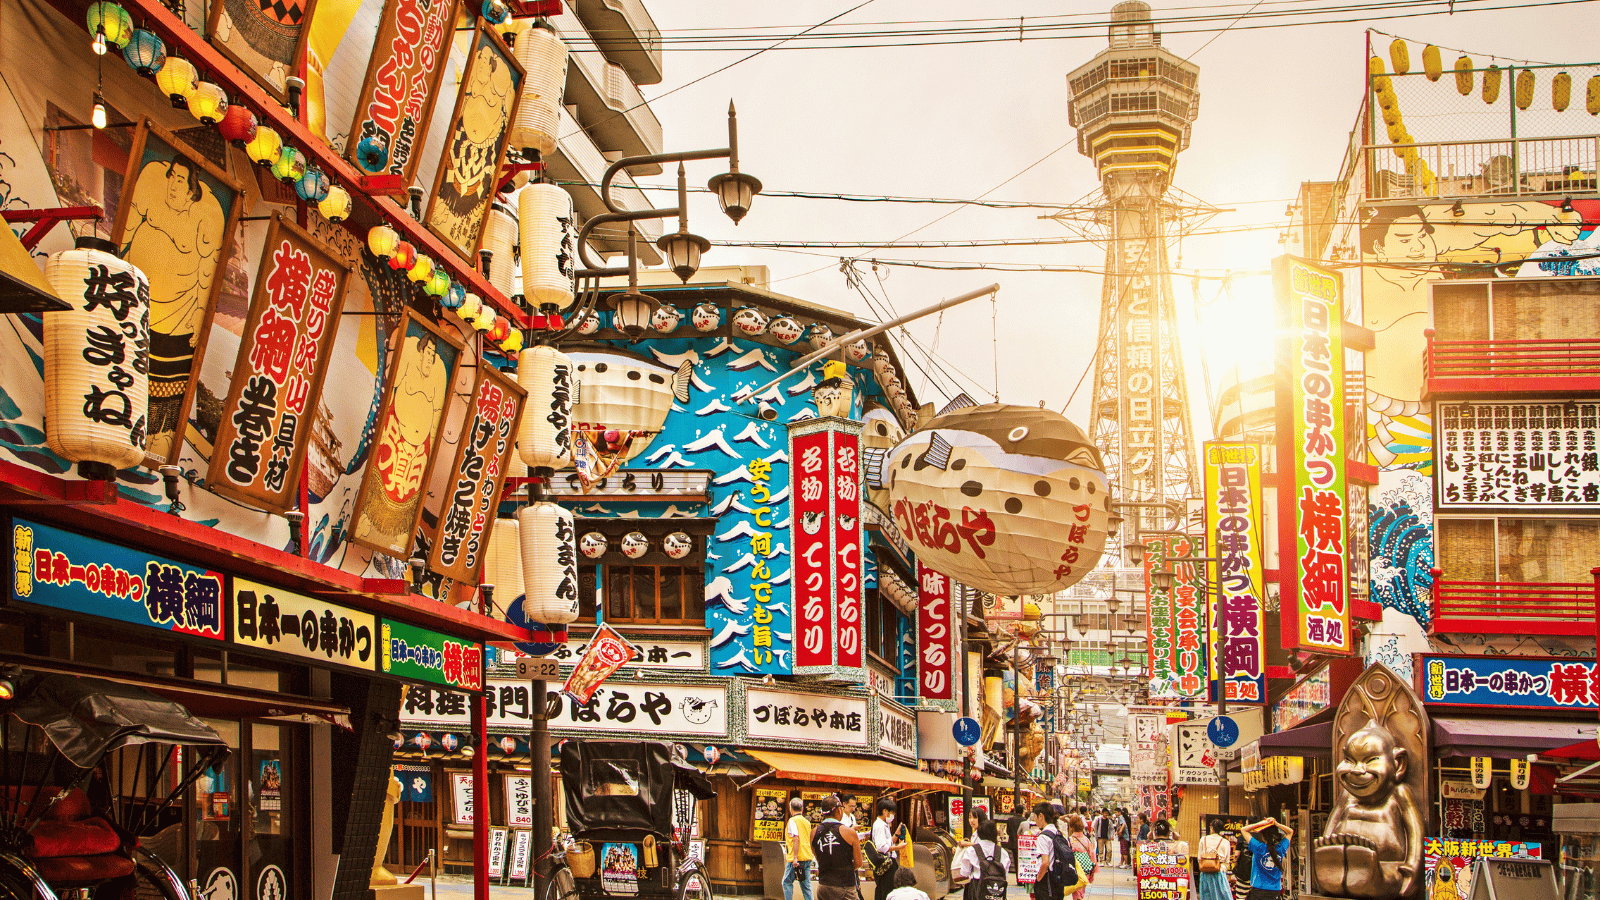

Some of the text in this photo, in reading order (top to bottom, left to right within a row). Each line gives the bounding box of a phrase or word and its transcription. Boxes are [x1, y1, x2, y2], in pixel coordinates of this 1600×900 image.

[229, 242, 312, 484] 横綱巻き
[266, 270, 335, 491] 盛り沢山具材
[442, 380, 502, 565] 揚げたこ焼き
[1210, 448, 1255, 464] 新世界
[1294, 267, 1343, 643] 新世界 日本一の串かつ 横綱 酒処
[1445, 453, 1460, 502] もち
[1462, 453, 1479, 502] うずら玉子
[1478, 453, 1495, 502] 紅しょうが
[1495, 453, 1512, 502] にんにく
[1512, 453, 1530, 502] 玉ねぎ
[1530, 453, 1546, 502] 山芋
[1547, 453, 1563, 502] しし唐
[1564, 453, 1581, 502] れんこん
[1581, 453, 1599, 502] 銀杏
[802, 446, 824, 655] 名物 てっちり
[837, 446, 857, 655] 名物 てっちり
[894, 496, 996, 559] づぼらや
[1053, 503, 1093, 580] づぼらや
[749, 458, 773, 665] 安うて何んでも旨い
[35, 549, 144, 601] 日本一の串かつ
[146, 562, 220, 634] 横綱
[237, 590, 371, 662] 日本一の串かつ
[391, 640, 442, 669] 日本一の串かつ
[443, 641, 482, 689] 横綱
[1430, 662, 1444, 698] 新世界
[1446, 670, 1547, 694] 日本一の串かつ
[753, 704, 862, 732] づぼらや本店
[1139, 853, 1177, 865] 食べ放題
[1428, 840, 1513, 858] 大阪新世界
